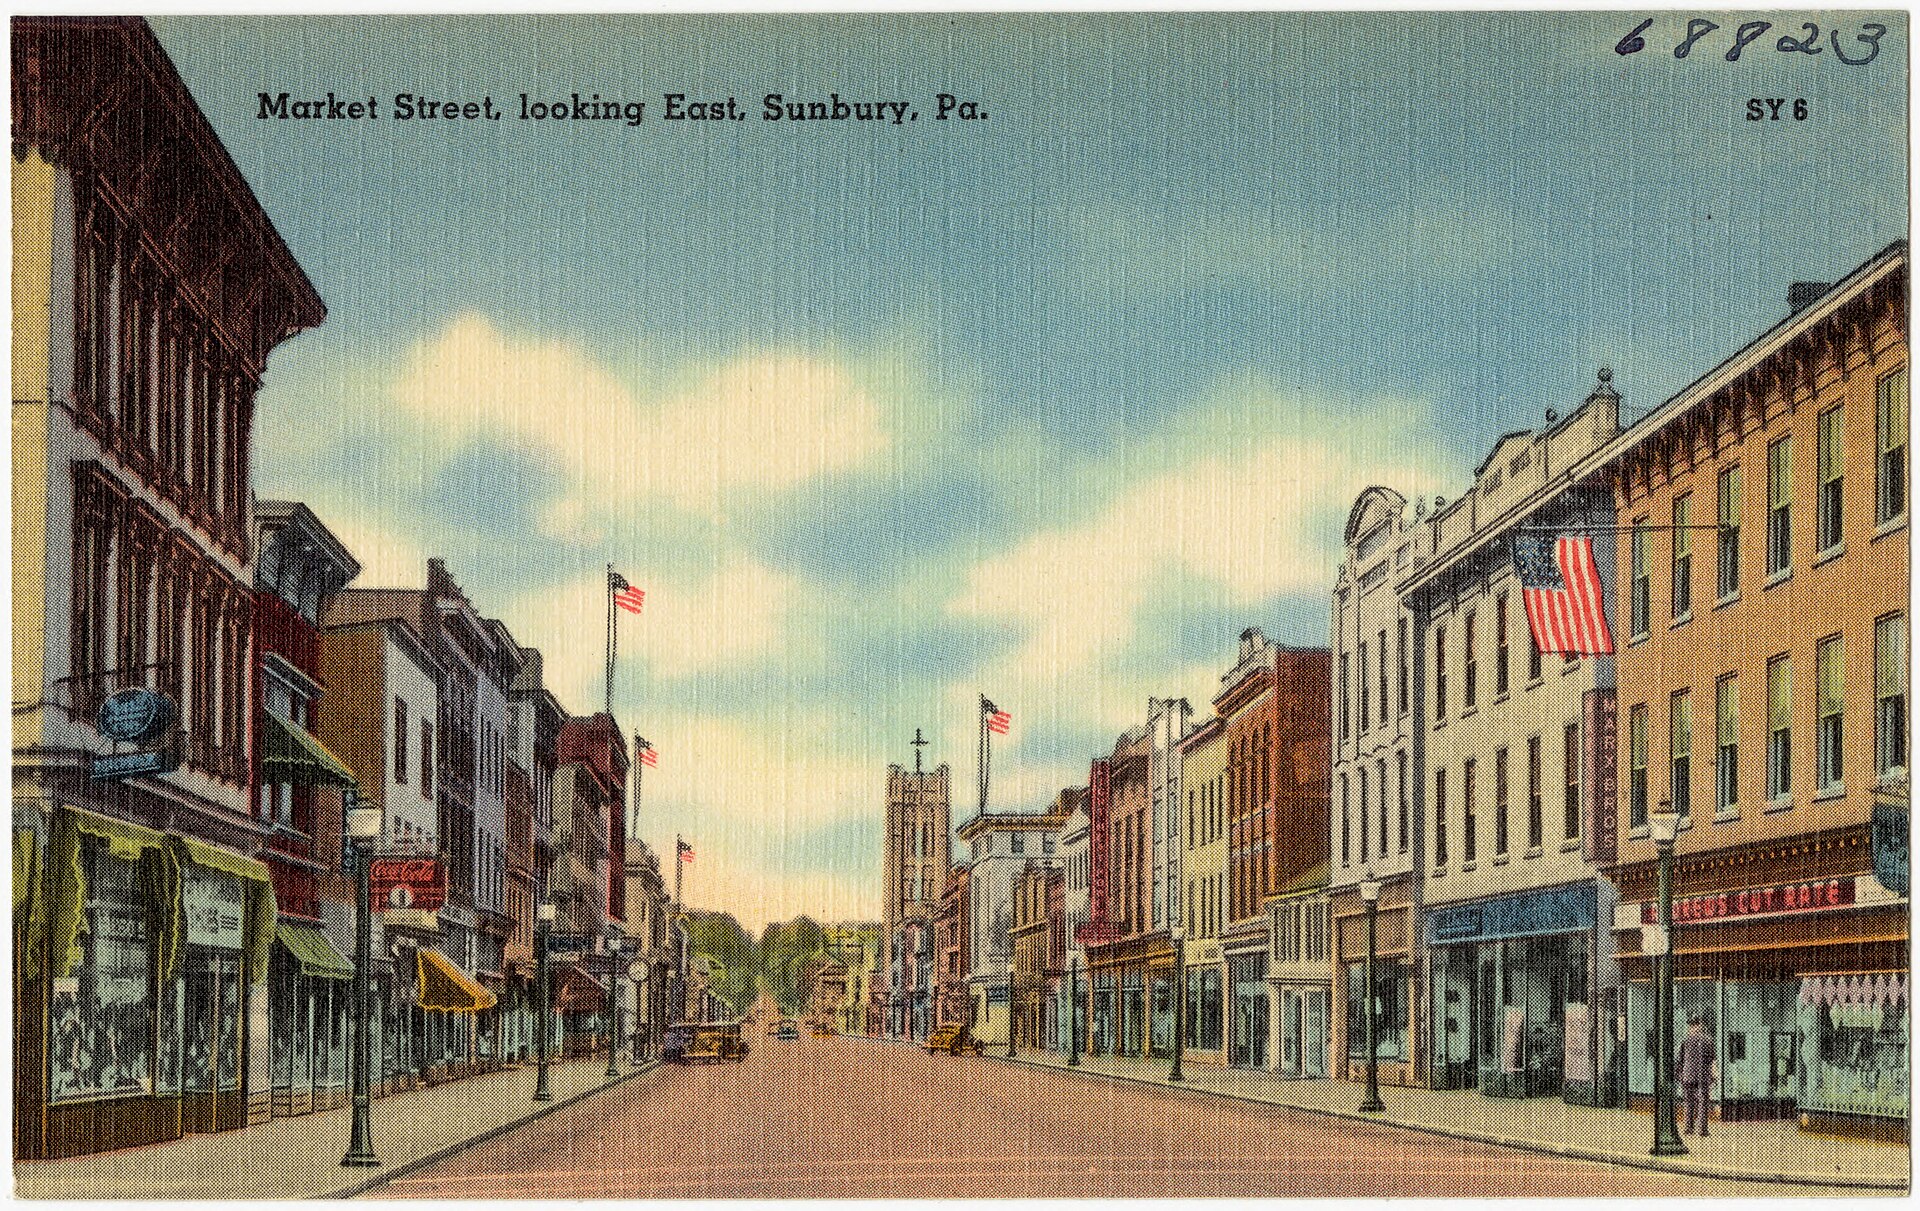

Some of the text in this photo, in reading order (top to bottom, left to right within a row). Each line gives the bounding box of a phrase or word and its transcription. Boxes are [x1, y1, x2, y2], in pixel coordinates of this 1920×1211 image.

[1615, 18, 1887, 65] 68823
[1603, 698, 1616, 848] MARX BROS
[1738, 888, 1775, 914] CUT
[1783, 879, 1841, 909] RATE
